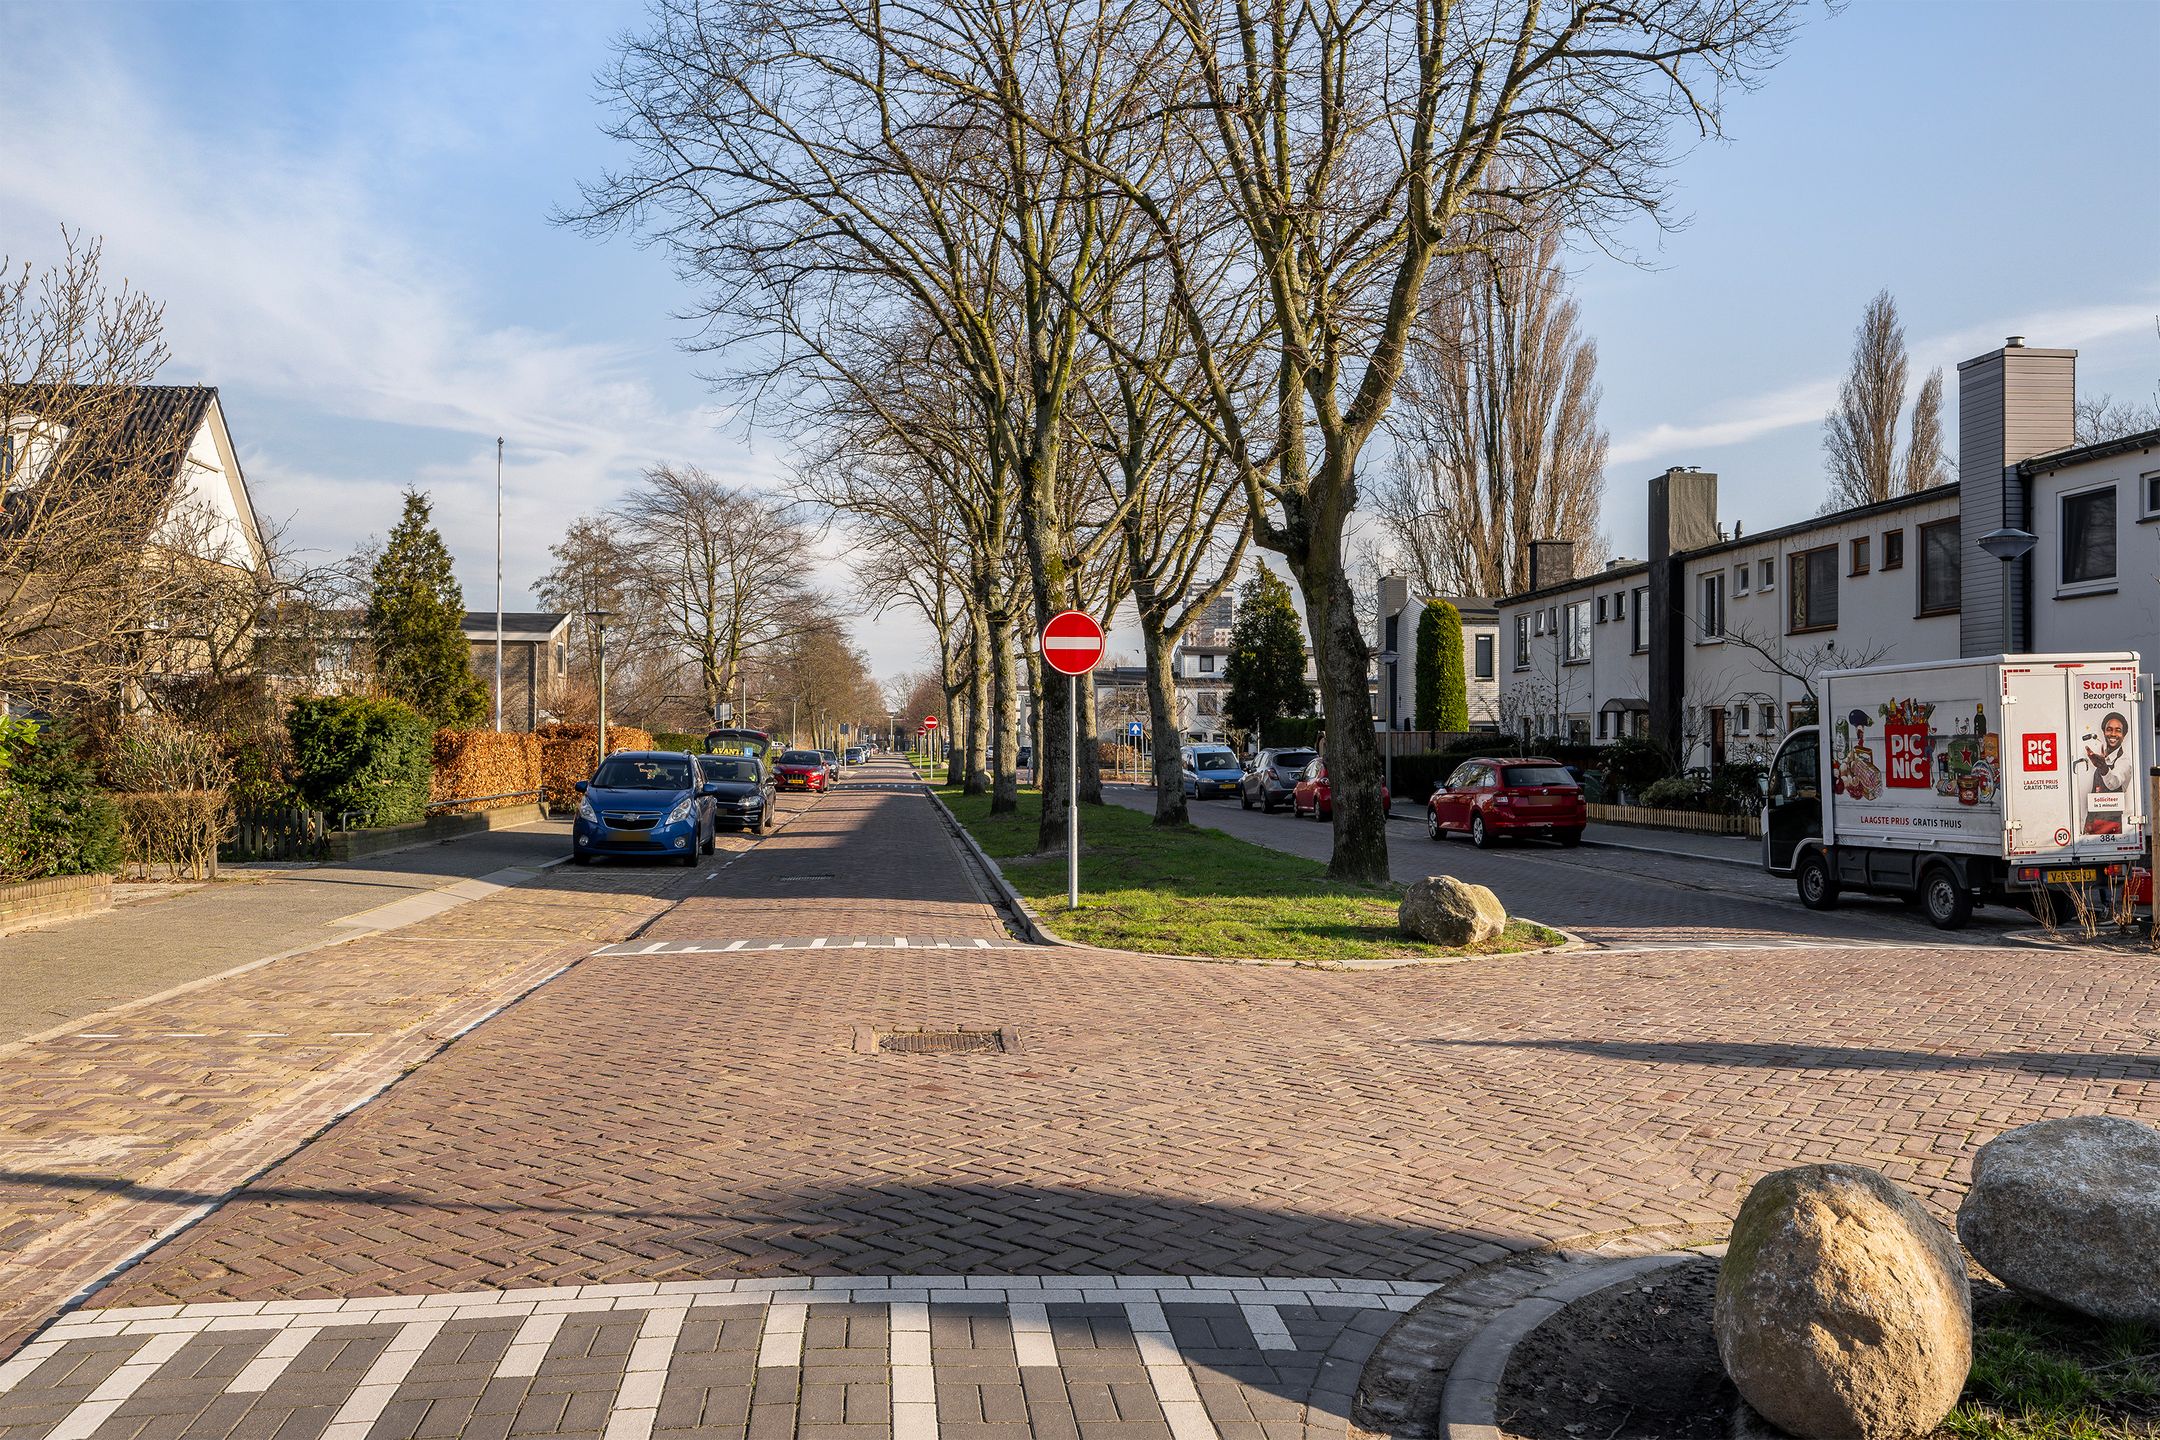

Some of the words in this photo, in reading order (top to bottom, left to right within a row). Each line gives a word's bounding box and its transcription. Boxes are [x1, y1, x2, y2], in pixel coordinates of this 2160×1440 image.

[2083, 680, 2108, 691] Stap
[2110, 680, 2122, 689] in!
[2083, 702, 2114, 711] gezocht
[1891, 733, 1922, 756] PIC
[2027, 739, 2052, 752] PIC
[1860, 815, 1890, 825] LAAGSTE
[1890, 817, 1910, 826] PRIJS
[1912, 818, 1938, 827] GRATIS
[1940, 819, 1962, 829] THUIS
[2100, 834, 2116, 843] 384
